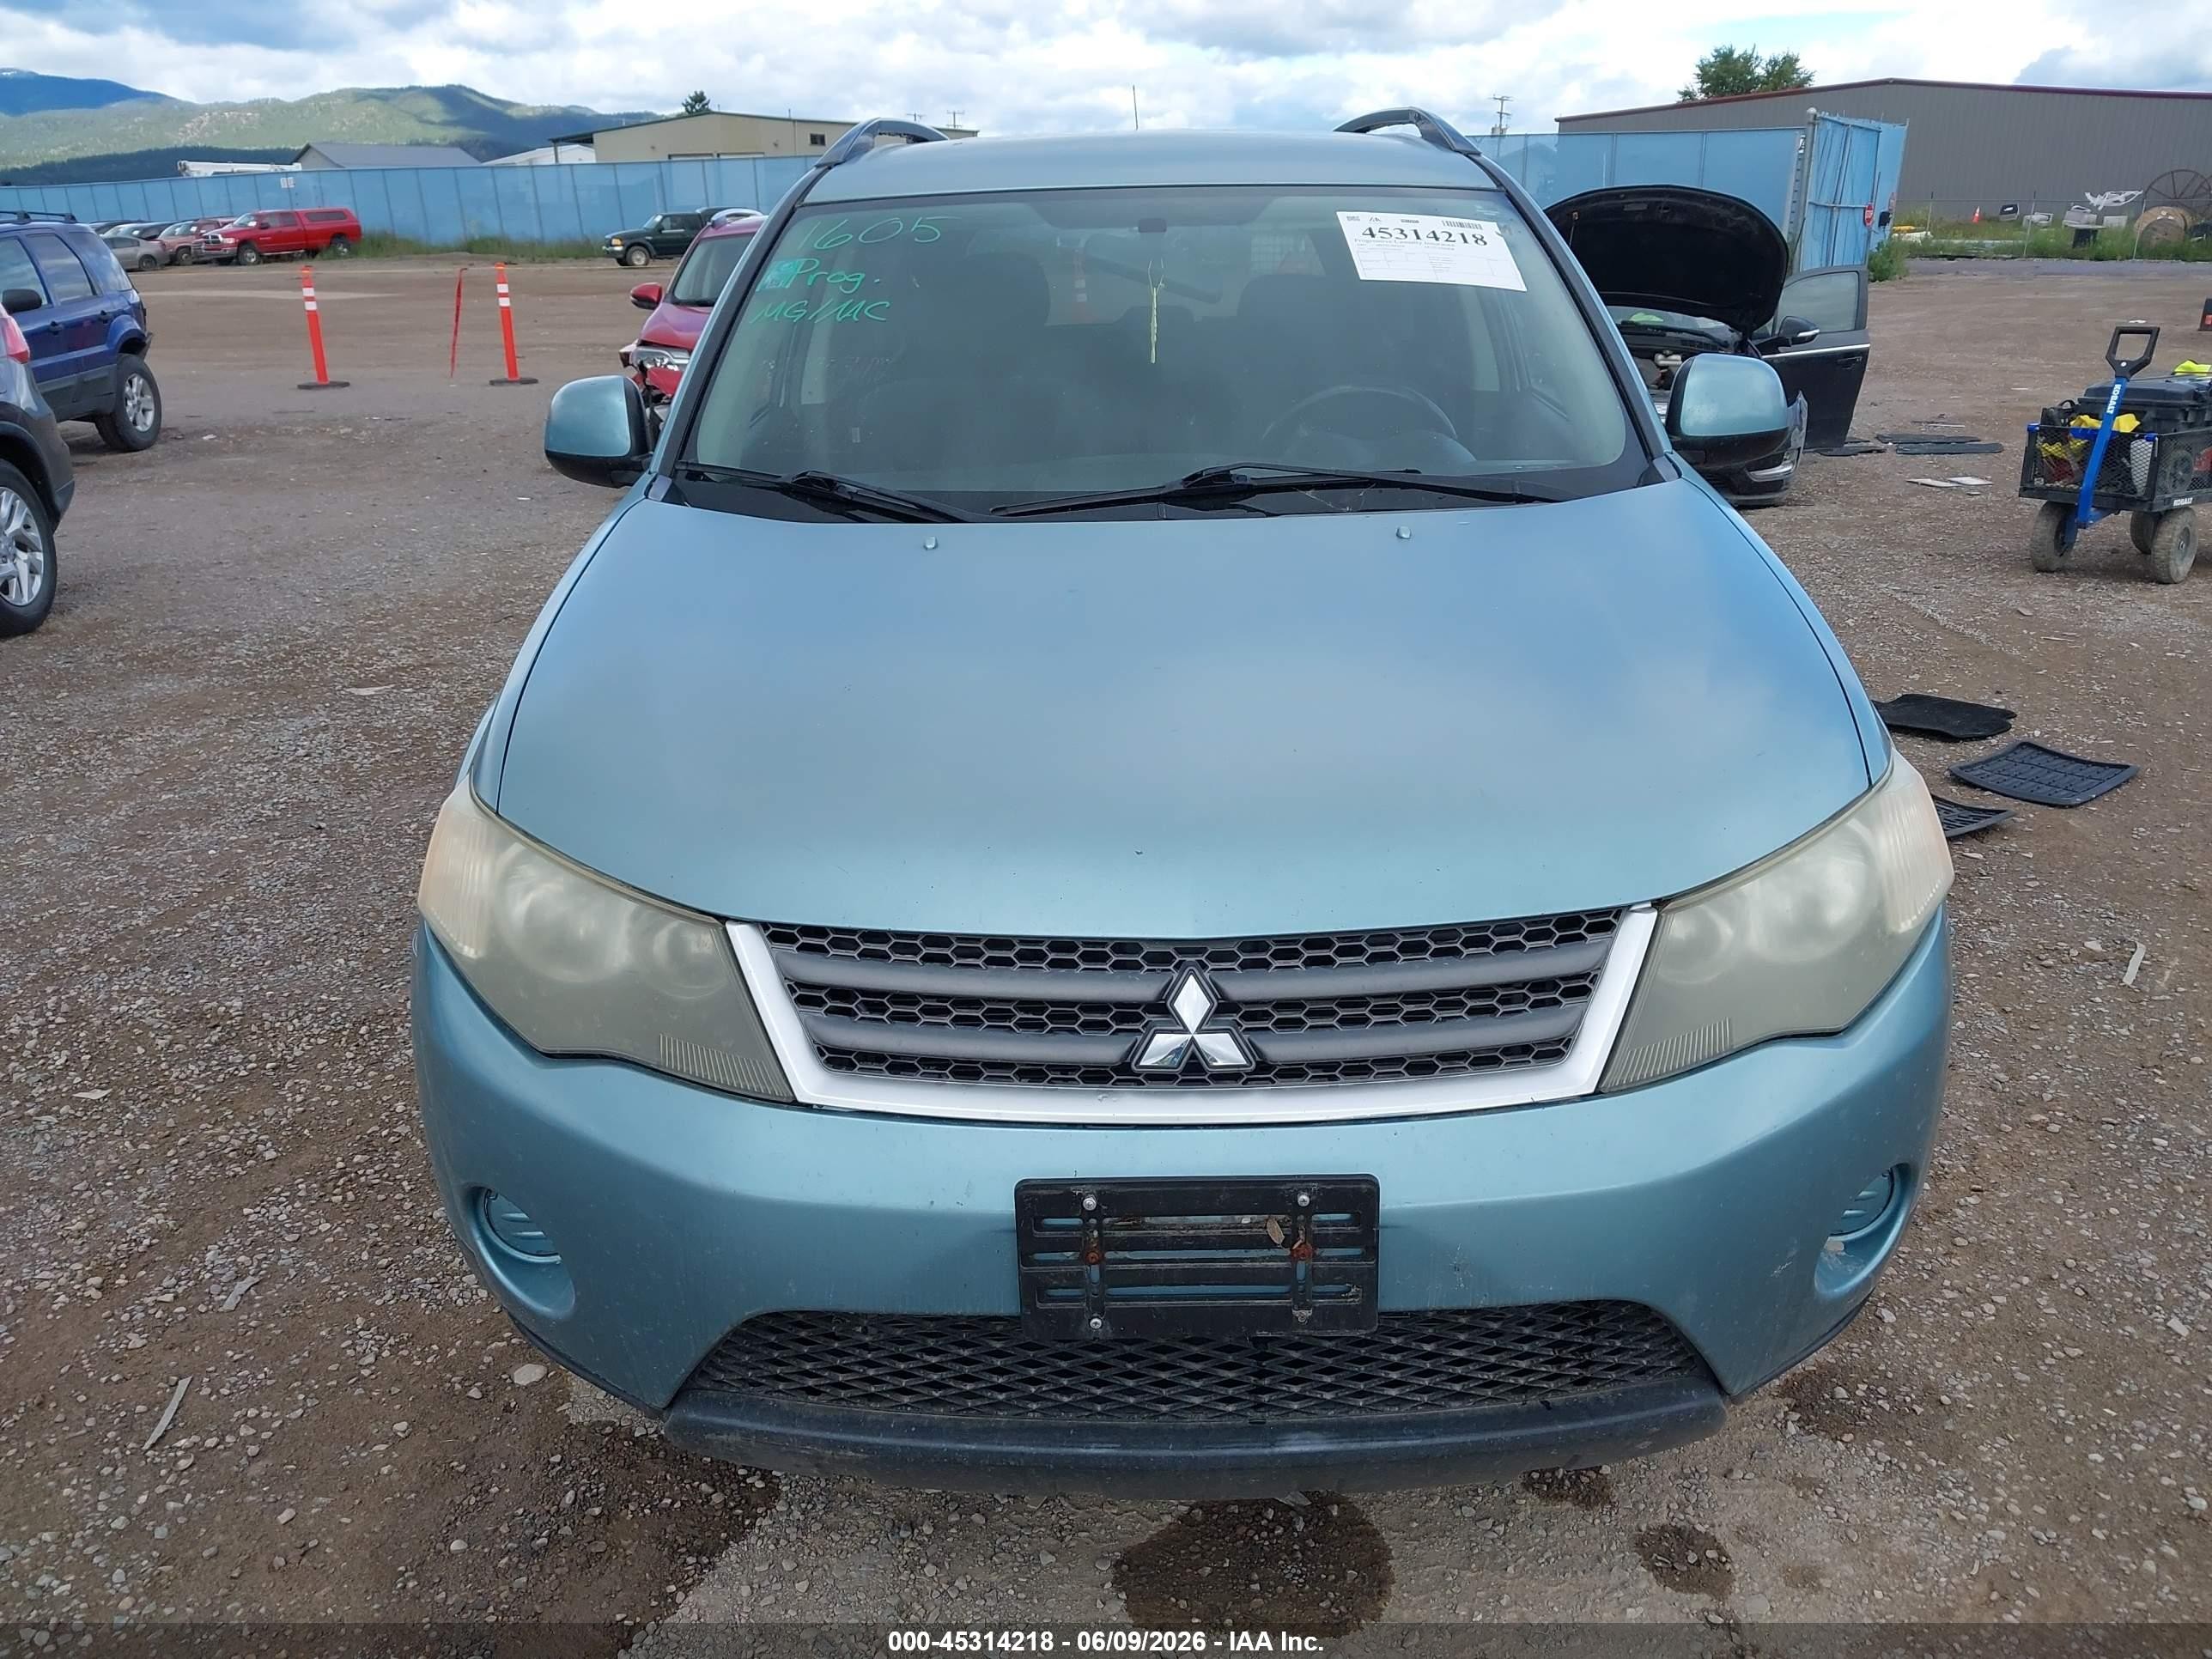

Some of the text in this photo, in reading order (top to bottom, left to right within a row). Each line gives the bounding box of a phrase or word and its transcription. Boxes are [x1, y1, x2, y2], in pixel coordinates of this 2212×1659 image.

[798, 216, 962, 250] 1605
[1362, 227, 1488, 246] 45314218
[787, 258, 880, 294] Prog.
[2106, 384, 2122, 414] KOBALT
